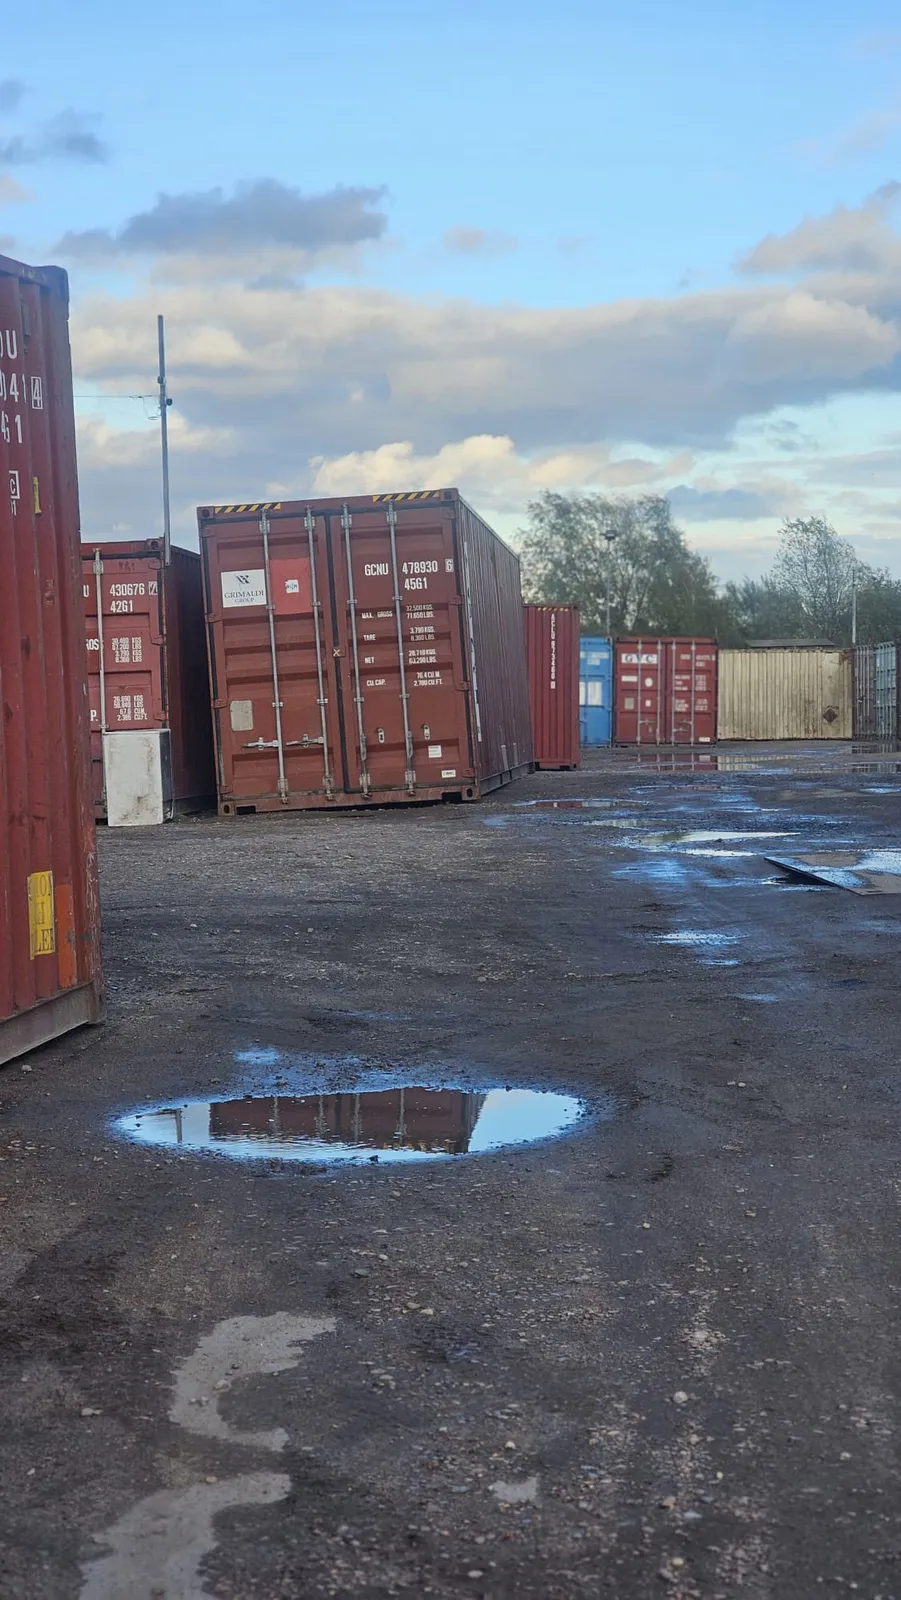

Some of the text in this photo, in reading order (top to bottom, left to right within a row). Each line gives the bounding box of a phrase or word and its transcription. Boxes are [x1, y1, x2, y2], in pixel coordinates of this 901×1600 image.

[32, 377, 42, 408] 4
[364, 559, 454, 576] GCNU 478930 6
[404, 577, 428, 590] 45G1
[83, 584, 90, 598] U
[109, 583, 145, 597] 430676
[224, 589, 264, 599] GRIMALDI
[110, 599, 133, 613] 42G1
[377, 610, 393, 618] GROSS
[363, 633, 377, 641] TARE
[364, 656, 375, 664] NET
